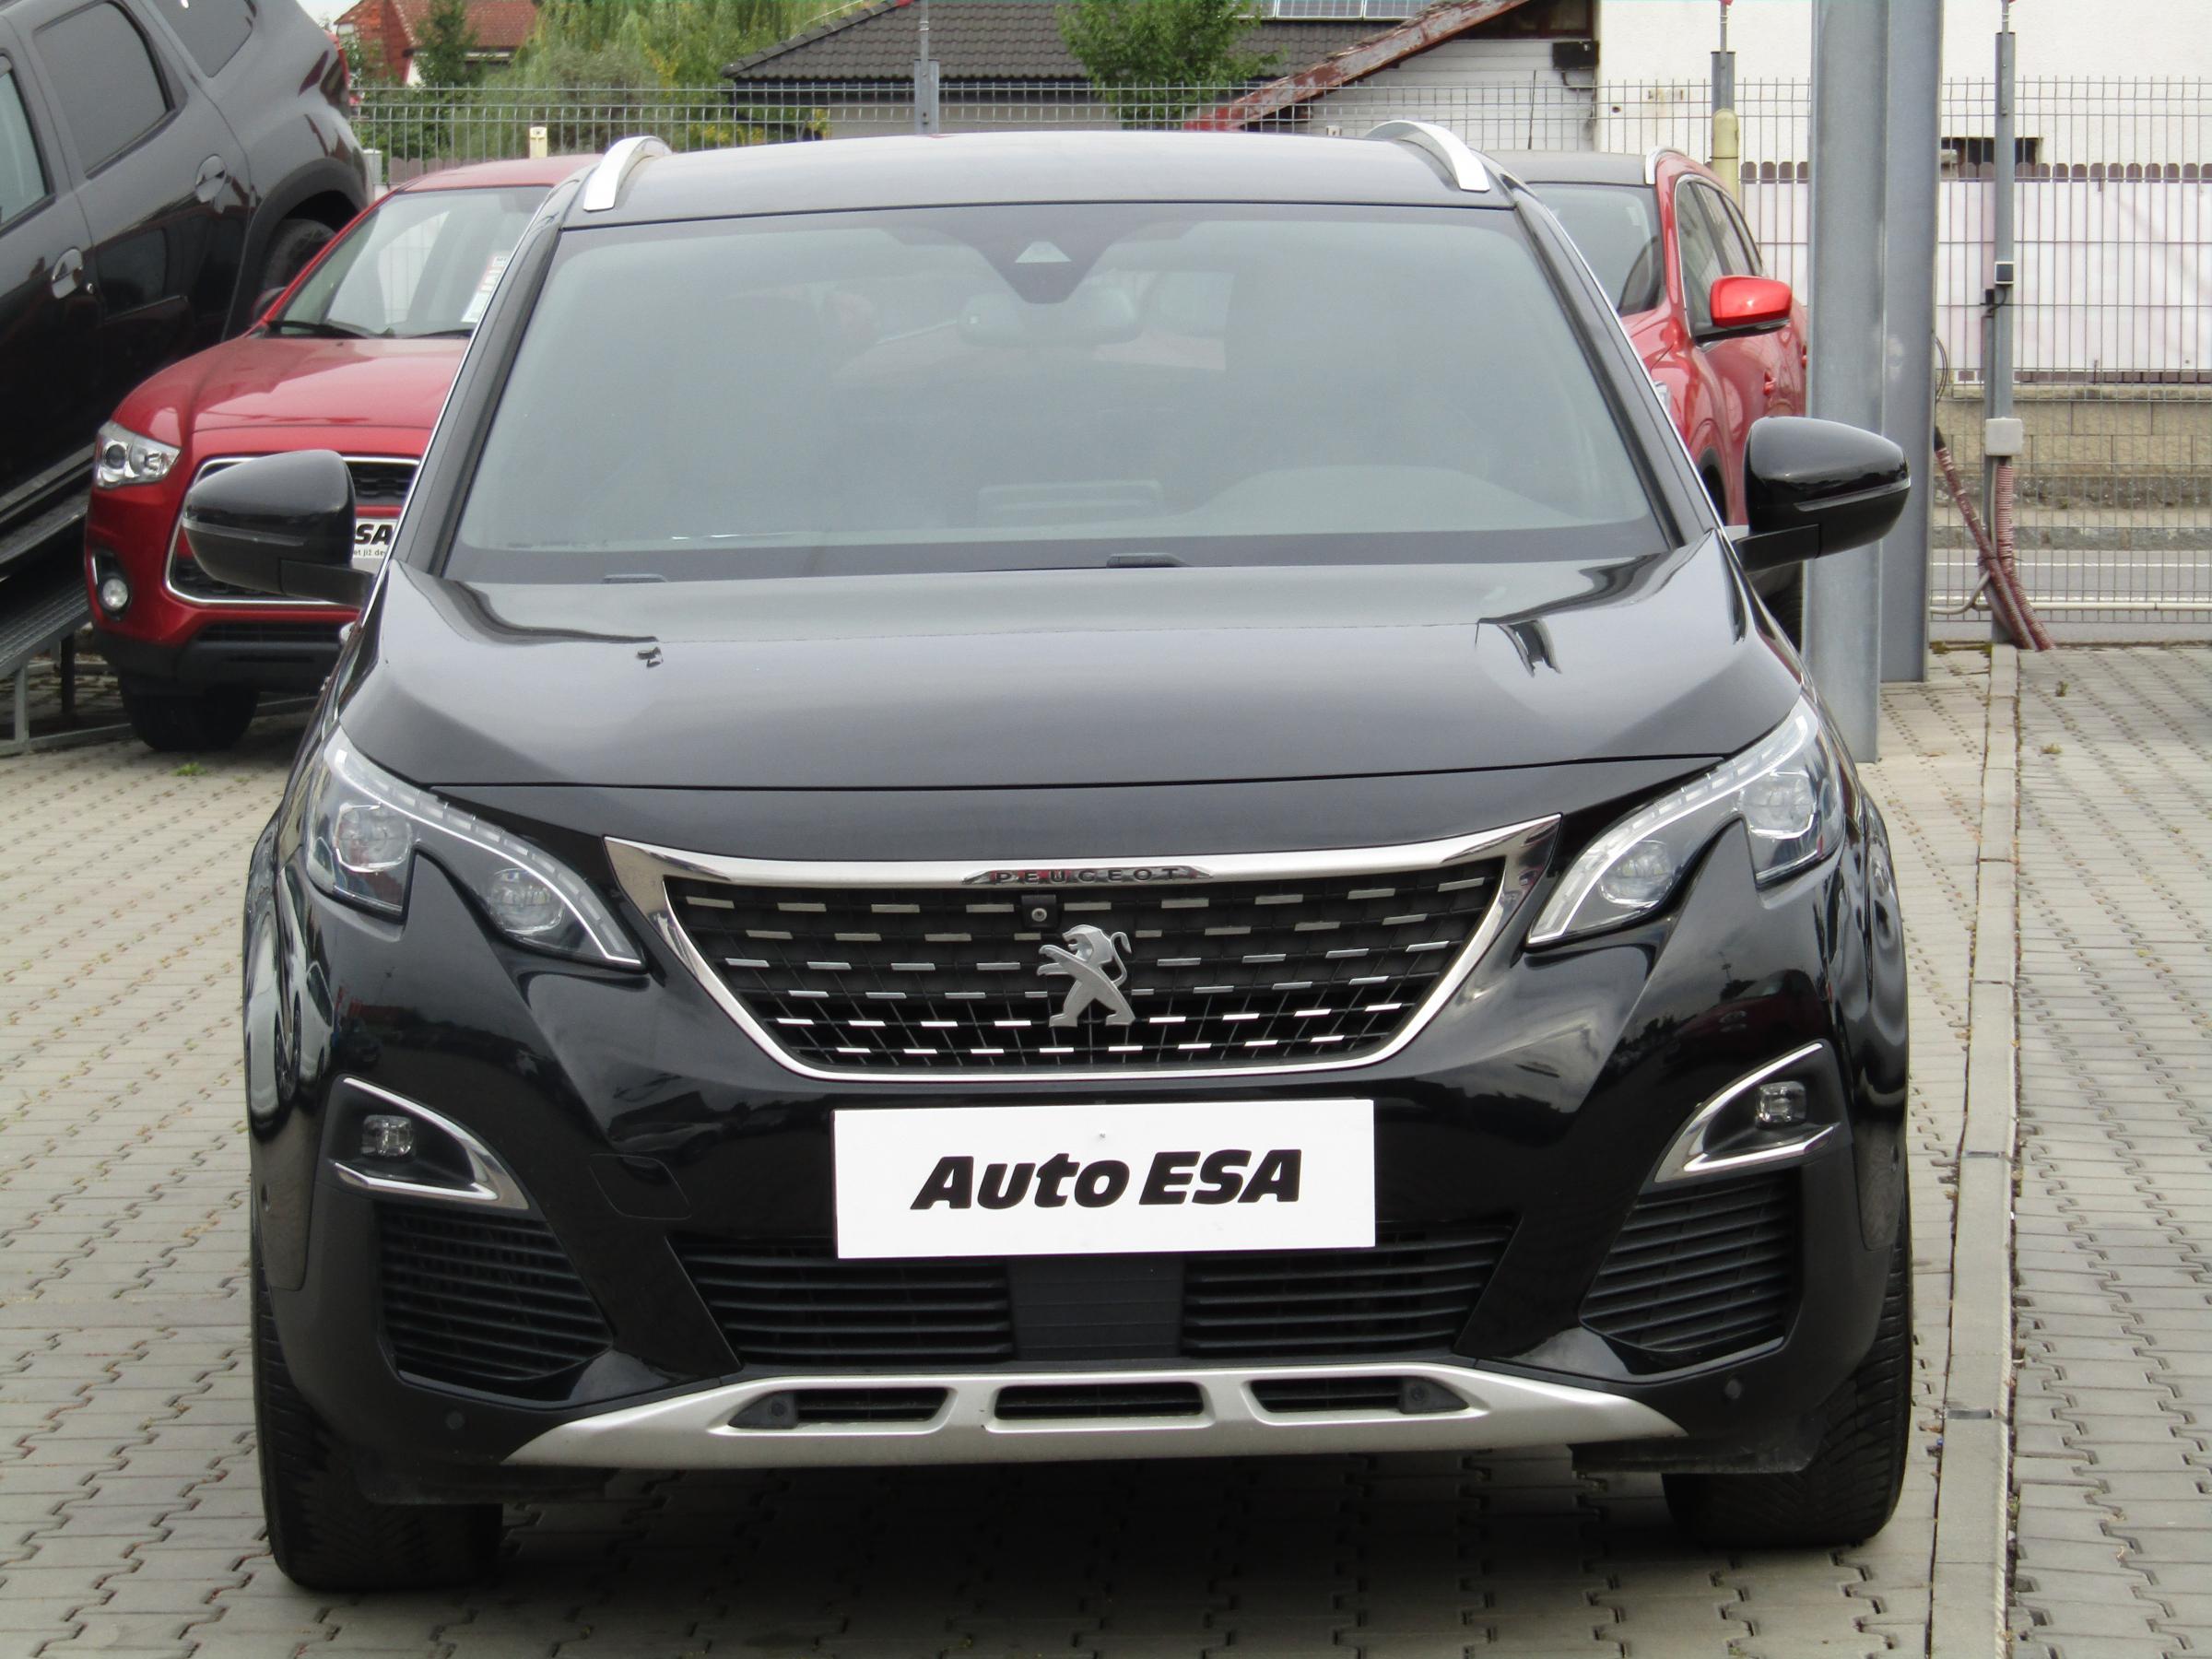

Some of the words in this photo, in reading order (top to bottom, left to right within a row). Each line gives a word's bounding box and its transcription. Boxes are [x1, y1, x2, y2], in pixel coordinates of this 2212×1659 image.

[354, 524, 394, 546] SA
[994, 867, 1180, 884] PEUGEOT
[910, 1153, 1130, 1209] Auto
[1138, 1149, 1301, 1206] ESA
